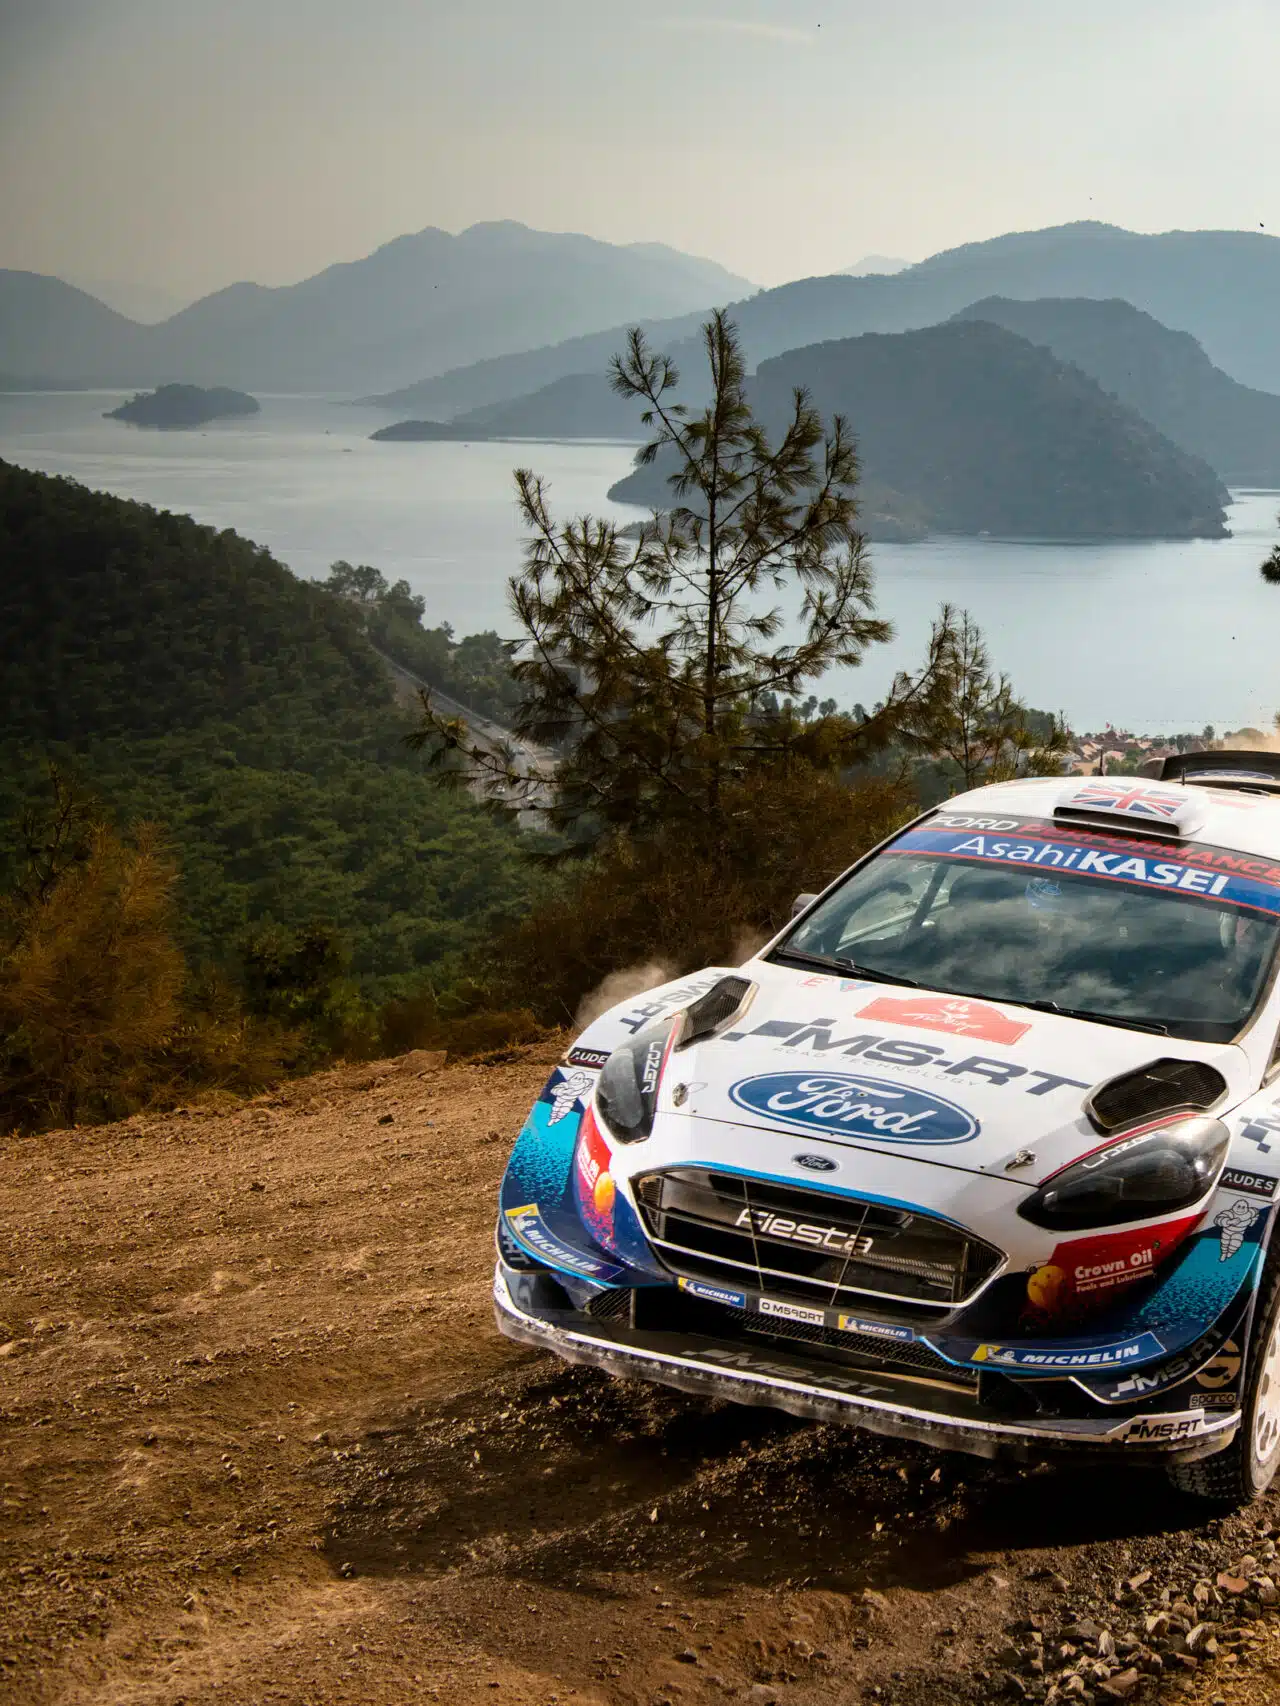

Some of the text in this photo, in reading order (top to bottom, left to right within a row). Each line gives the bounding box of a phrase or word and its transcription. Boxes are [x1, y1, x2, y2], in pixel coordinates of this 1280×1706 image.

[925, 815, 1019, 832] FORD
[570, 1051, 609, 1066] AUDE
[800, 1023, 1092, 1097] MS-RT
[766, 1078, 928, 1135] Ford
[800, 1156, 829, 1170] Ford
[1222, 1171, 1275, 1191] AUDES
[735, 1207, 874, 1254] Fiesta
[525, 1229, 603, 1272] MICHELIN
[1075, 1248, 1153, 1279] Crown Oil
[697, 1286, 740, 1303] MICHELIN
[860, 1322, 908, 1338] MICHELIN
[1021, 1345, 1140, 1364] MICHELIN
[1138, 1418, 1202, 1439] MS-RT
